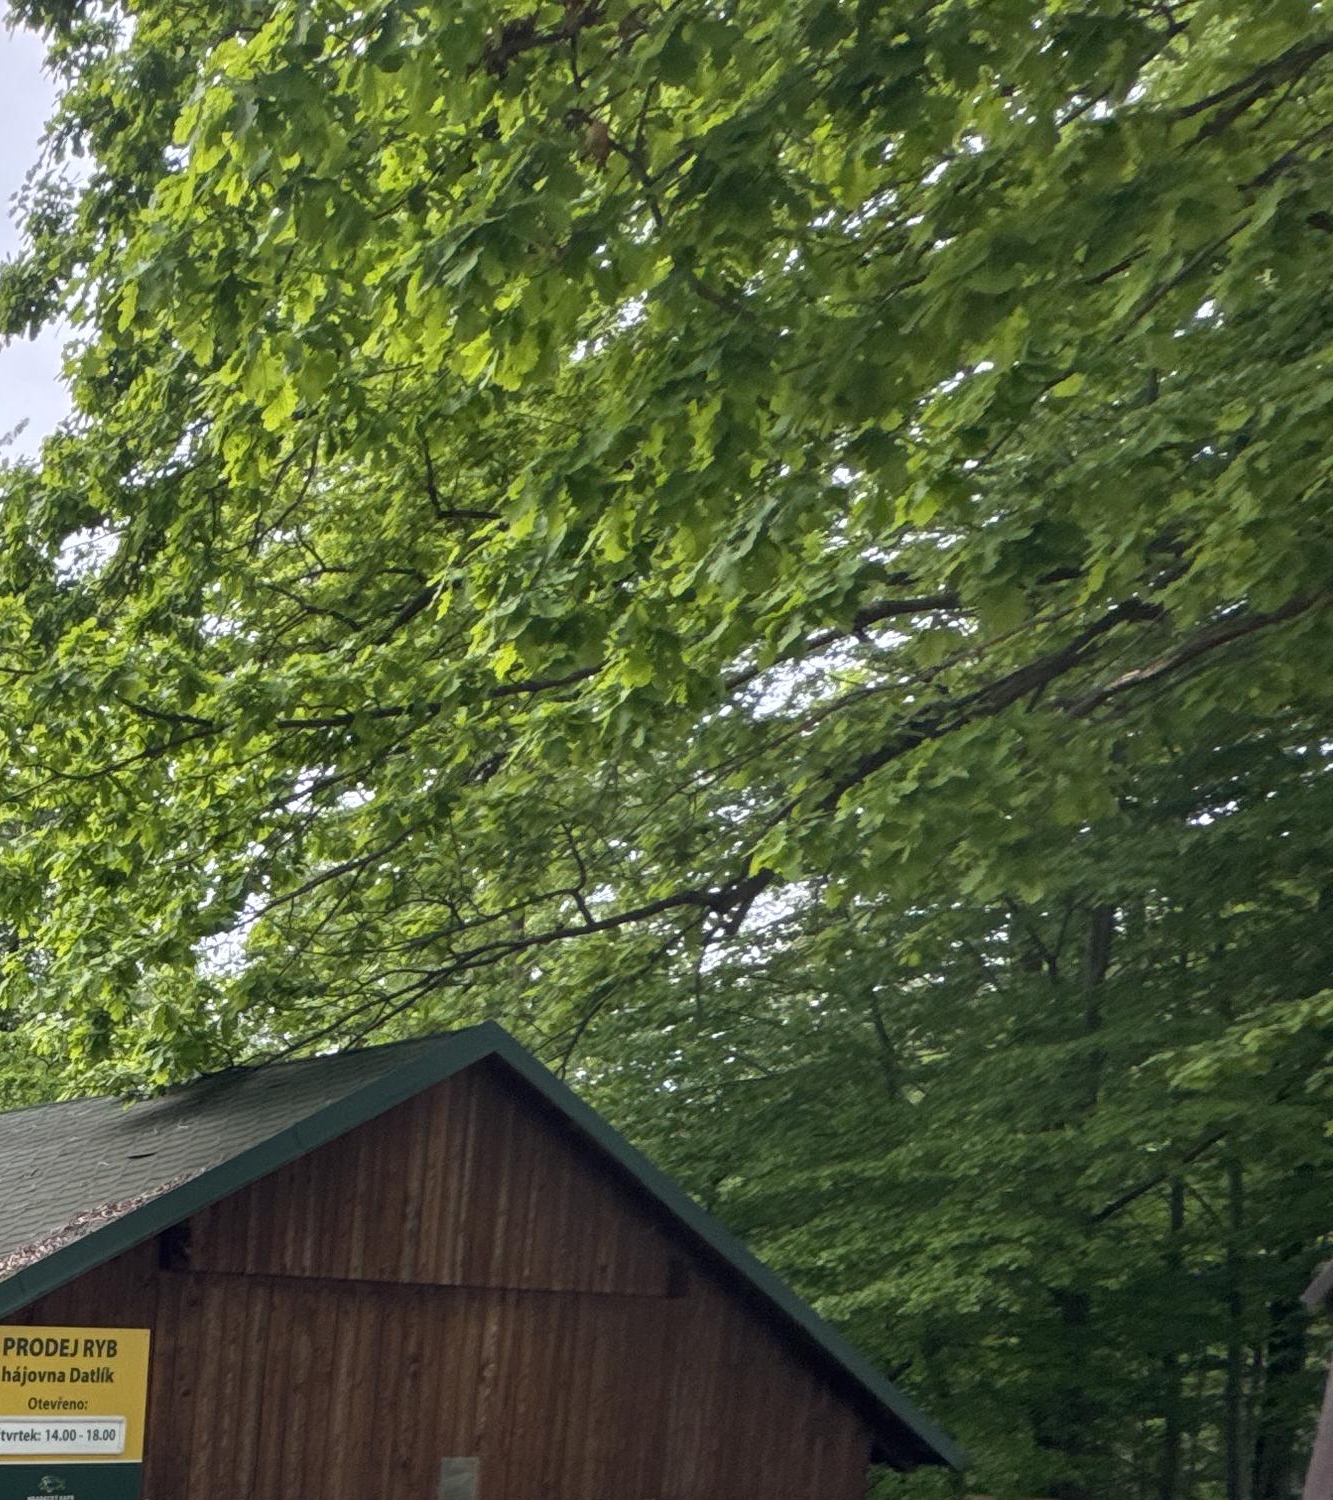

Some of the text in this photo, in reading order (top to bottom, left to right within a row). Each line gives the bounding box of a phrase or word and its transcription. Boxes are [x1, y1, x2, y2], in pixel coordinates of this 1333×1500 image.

[2, 1337, 118, 1358] PRODEJ RYB
[1, 1366, 114, 1386] hájovna Datlík
[27, 1396, 88, 1410] Otevřeno:
[45, 1429, 77, 1442] 14.00
[86, 1429, 116, 1441] 18.00
